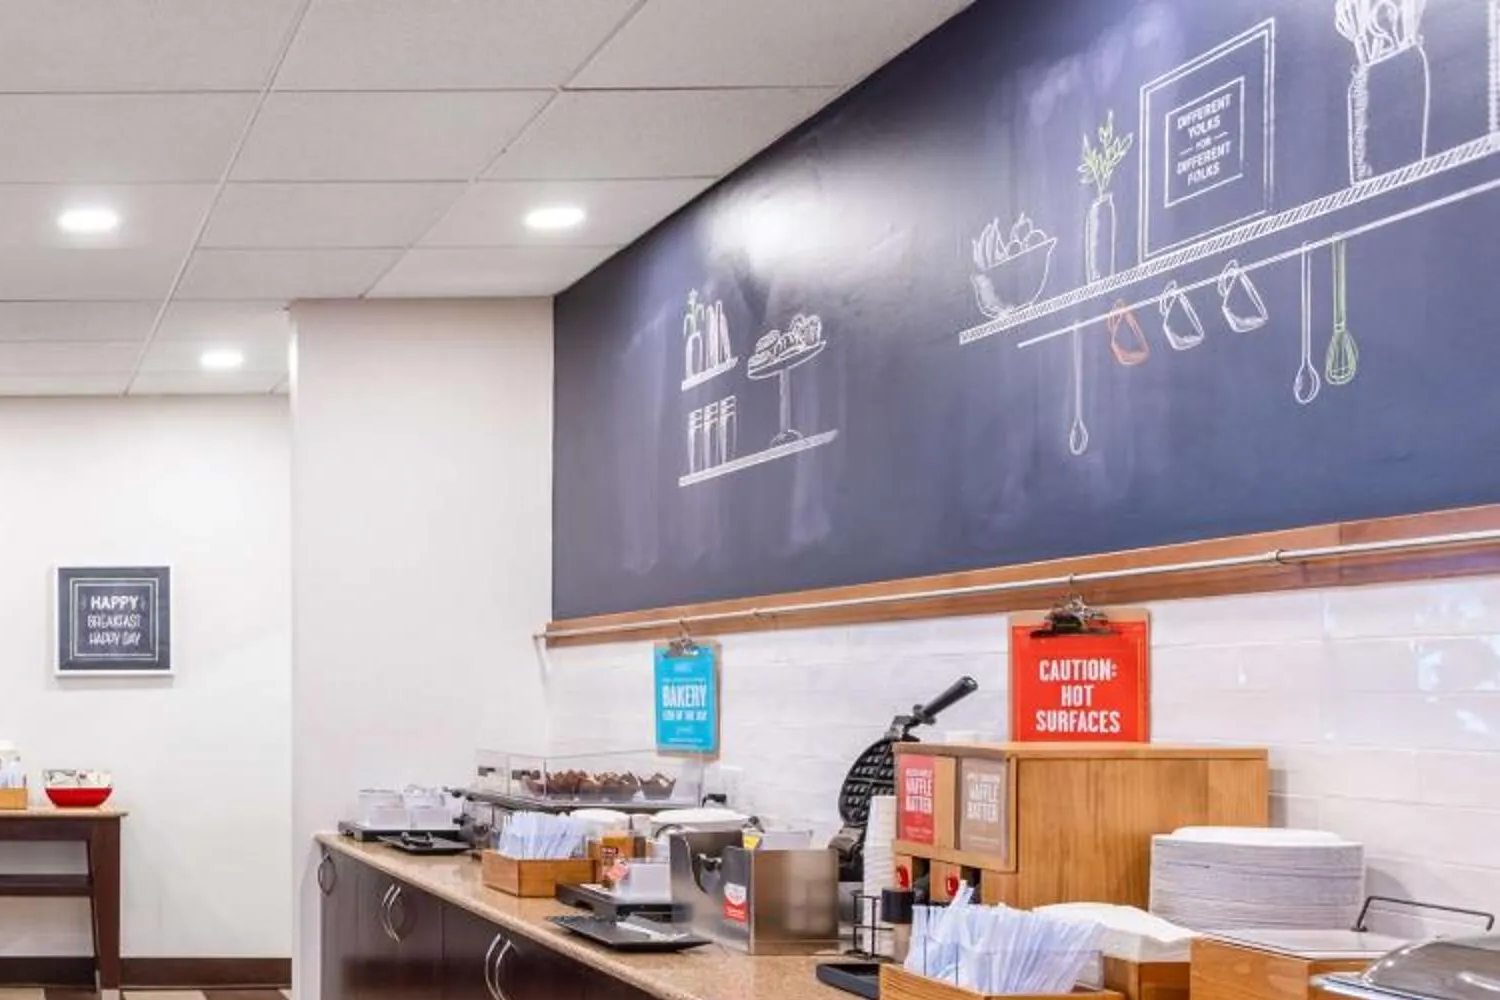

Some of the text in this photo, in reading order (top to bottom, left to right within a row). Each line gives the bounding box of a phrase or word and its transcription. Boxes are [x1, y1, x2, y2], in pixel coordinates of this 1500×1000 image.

[1177, 92, 1232, 130] DIFFERENT
[1187, 114, 1221, 139] YOLKS
[1176, 139, 1231, 176] DIFFERENT
[1187, 160, 1220, 187] FOLKS
[90, 595, 139, 611] HAPPY
[86, 613, 142, 629] BREAKFAST
[1039, 658, 1118, 682] CAUTION:
[661, 683, 708, 708] BAKERY
[1060, 684, 1095, 708] HOT
[1035, 709, 1121, 734] SURFACES
[905, 776, 933, 796] WAFFLE
[967, 781, 1000, 804] WAFFLE
